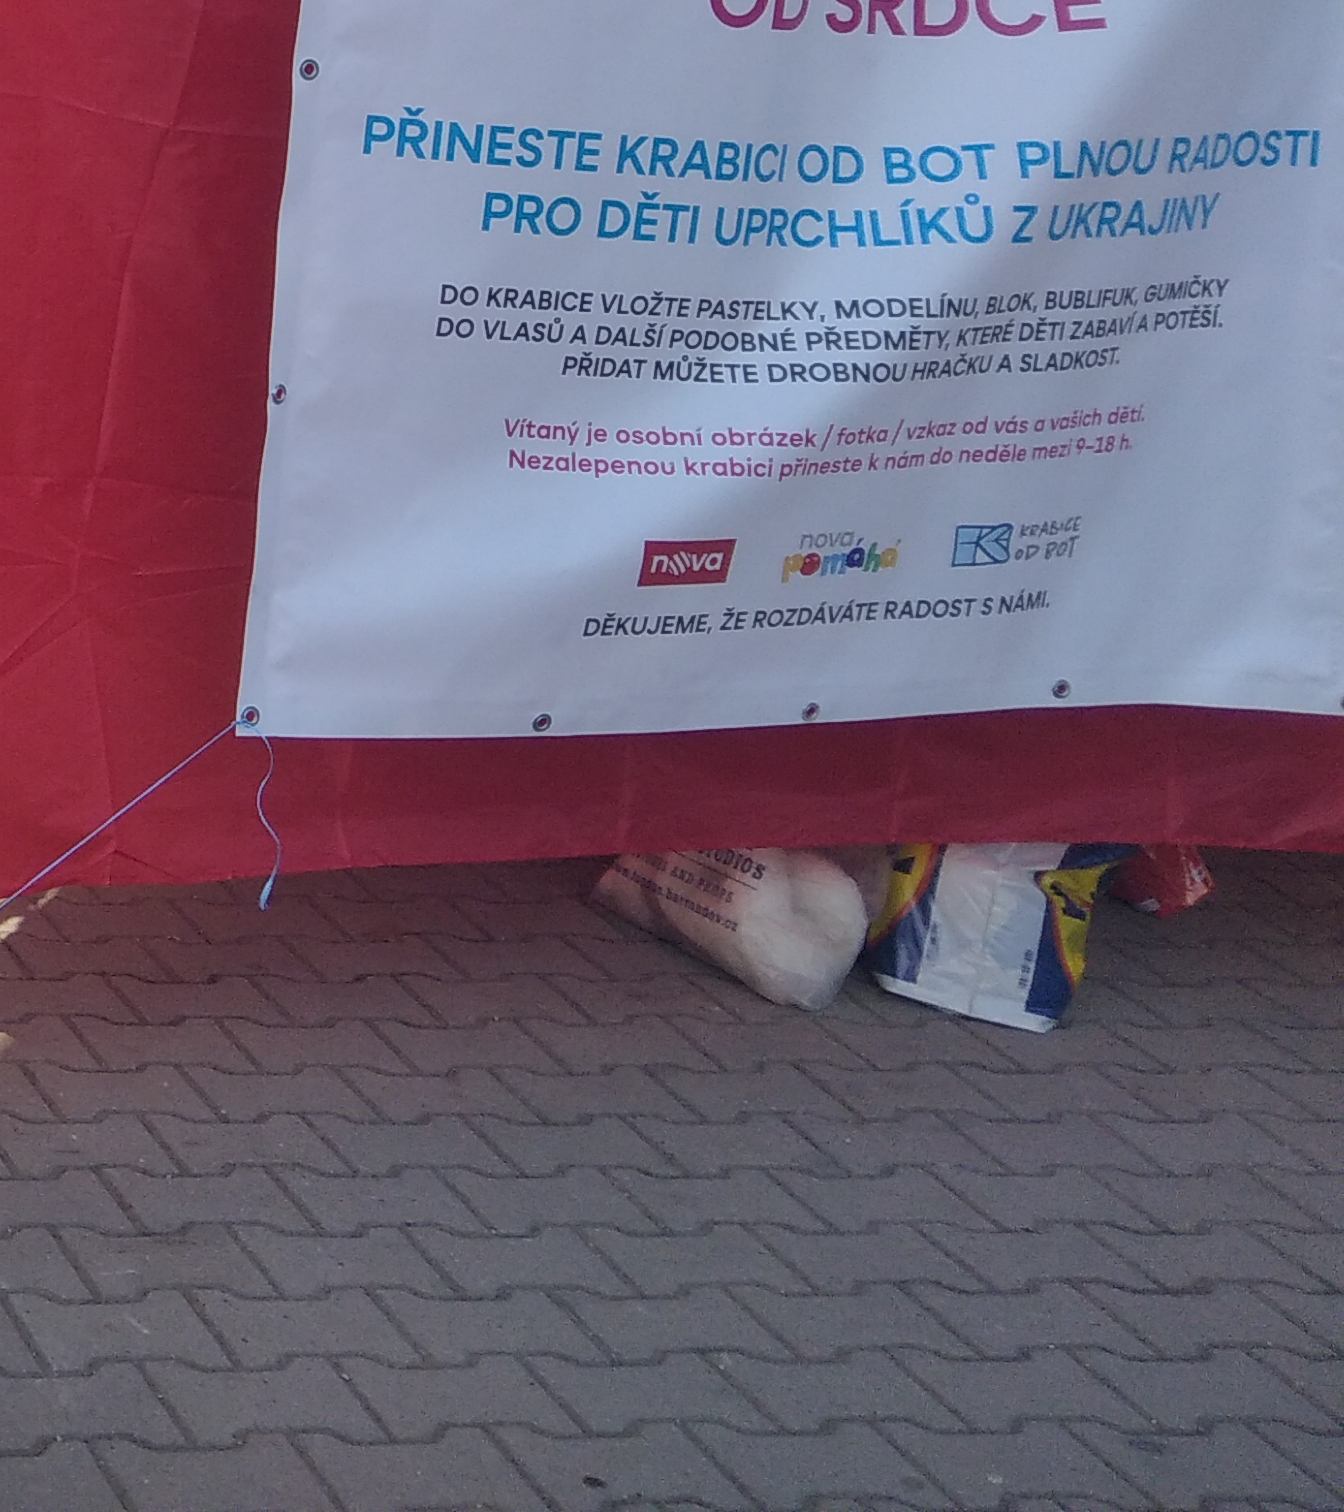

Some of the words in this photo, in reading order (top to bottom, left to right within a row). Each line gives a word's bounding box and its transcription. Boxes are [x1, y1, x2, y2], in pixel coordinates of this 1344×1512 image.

[361, 106, 604, 173] PŘINESTE
[615, 134, 789, 183] KRABICI
[797, 143, 865, 185] OD
[882, 142, 996, 185] BOT
[1016, 136, 1160, 181] PLNOU
[1168, 128, 1322, 174] RADOSTI
[481, 190, 582, 237] PRO
[596, 190, 702, 245] DĚTI
[714, 192, 995, 248] UPRCHLÍKŮ
[1011, 204, 1039, 244] Z
[1046, 192, 1222, 241] UKRAJINY
[439, 284, 480, 306] DO
[485, 287, 594, 314] KRABICE
[600, 290, 692, 318] VLOŽTE
[696, 298, 827, 324] PASTELKY,
[835, 291, 981, 320] MODELÍNU,
[984, 292, 1038, 316] BLOK,
[1043, 285, 1140, 312] BUBLIFUK,
[1144, 274, 1230, 303] GUMIČKY
[435, 316, 475, 338] DO
[482, 317, 566, 344] VLASŮ
[569, 324, 588, 345] A
[594, 323, 668, 349] DALŠÍ
[668, 326, 799, 353] PODOBNÉ
[805, 325, 950, 352] PŘEDMĚTY,
[955, 320, 1015, 348] KTERÉ
[1018, 311, 1066, 341] DĚTI
[1069, 310, 1135, 340] ZABAVÍ
[1136, 314, 1149, 333] A
[1153, 303, 1224, 330] POTĚŠÍ.
[561, 352, 647, 379] PŘIDAT
[653, 354, 760, 384] MŮŽETE
[767, 360, 907, 384] DROBNOU
[911, 351, 993, 381] HRAČKU
[996, 352, 1013, 373] A
[1019, 346, 1120, 373] SLADKOST.
[504, 417, 580, 445] Vítaný
[585, 422, 608, 447] je
[615, 426, 703, 447] osobní
[710, 426, 817, 448] obrázek
[836, 426, 889, 447] fotka
[906, 419, 957, 441] vzkaz
[961, 415, 989, 435] od
[994, 414, 1029, 435] vás
[1033, 418, 1046, 433] a
[1050, 408, 1102, 433] vašich
[1107, 403, 1146, 426] dětí.
[508, 449, 677, 479] Nezalepenou
[683, 456, 774, 479] krabici
[778, 456, 863, 482] přineste
[867, 453, 879, 472] k
[884, 449, 925, 470] nám
[929, 447, 953, 466] do
[959, 442, 1028, 464] neděle
[1032, 438, 1072, 460] mezi
[1119, 435, 1133, 451] h.
[649, 550, 725, 577] nova
[799, 531, 855, 550] nova
[1044, 535, 1080, 560] BOT
[583, 612, 713, 638] DĚKUJEME,
[719, 607, 749, 631] ŽE
[752, 598, 880, 629] ROZDÁVÁTE
[883, 597, 977, 621] RADOST
[980, 598, 993, 616] S
[998, 589, 1051, 615] NÁMI.
